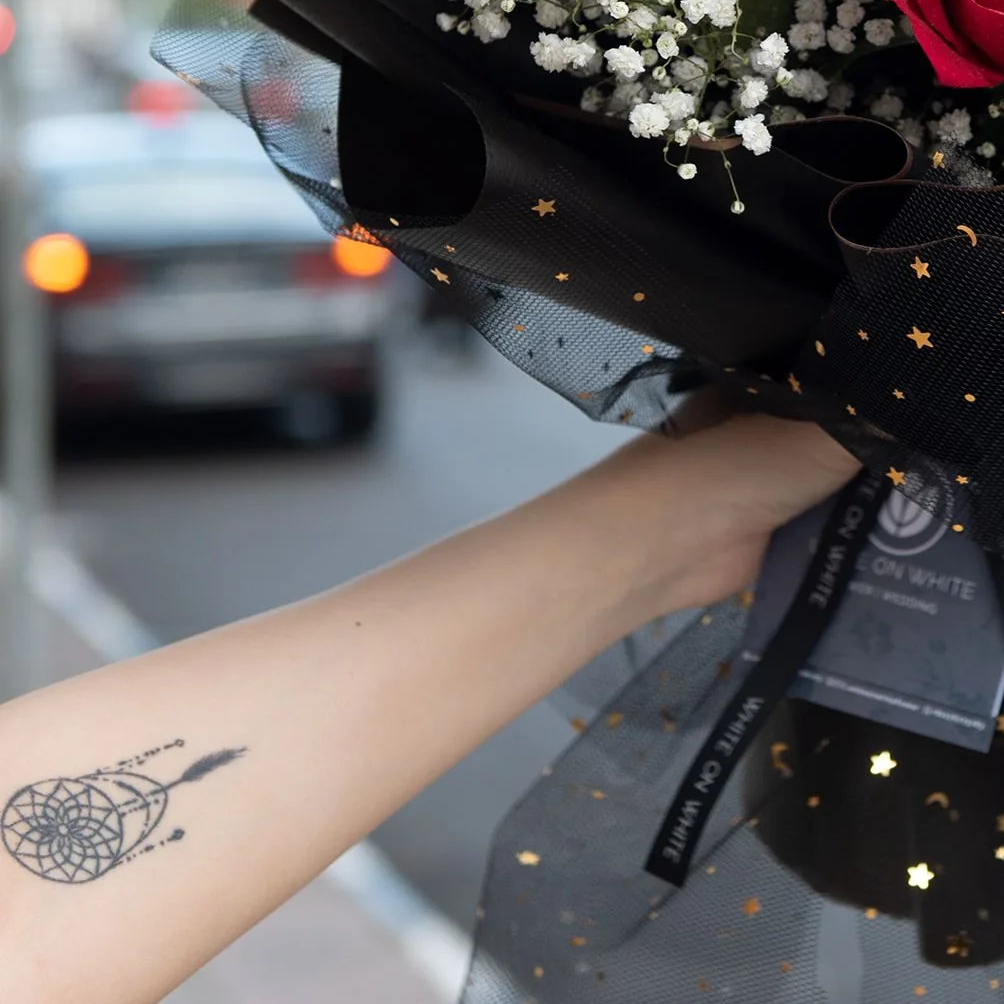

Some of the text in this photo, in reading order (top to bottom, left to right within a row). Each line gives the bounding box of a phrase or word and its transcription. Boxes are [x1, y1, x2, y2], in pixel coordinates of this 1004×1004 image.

[871, 555, 905, 580] ON
[907, 563, 977, 602] WHITE
[714, 696, 765, 757] WHITE
[693, 760, 722, 793] ON
[662, 799, 702, 864] WHITE
